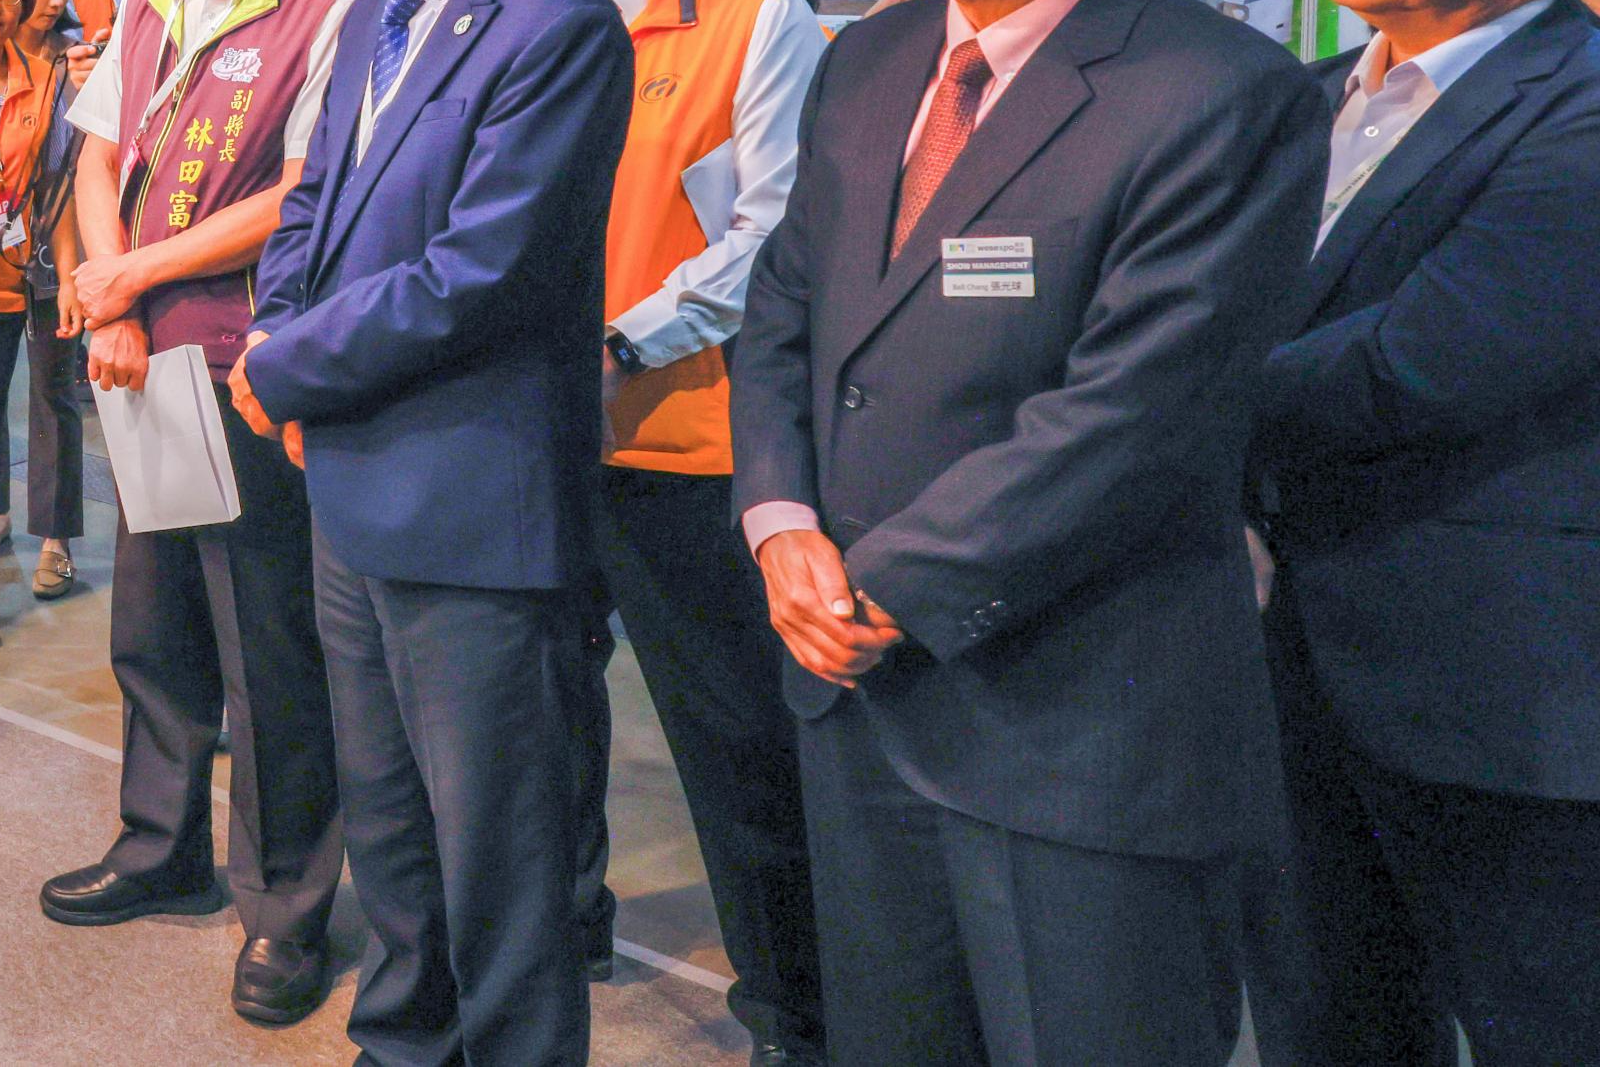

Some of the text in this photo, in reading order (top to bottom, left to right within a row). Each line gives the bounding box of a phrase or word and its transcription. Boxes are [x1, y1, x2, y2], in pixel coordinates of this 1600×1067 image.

[218, 89, 254, 163] 副縣長
[167, 117, 215, 229] 林田富
[946, 261, 1029, 270] SHOW MANAGEMENT
